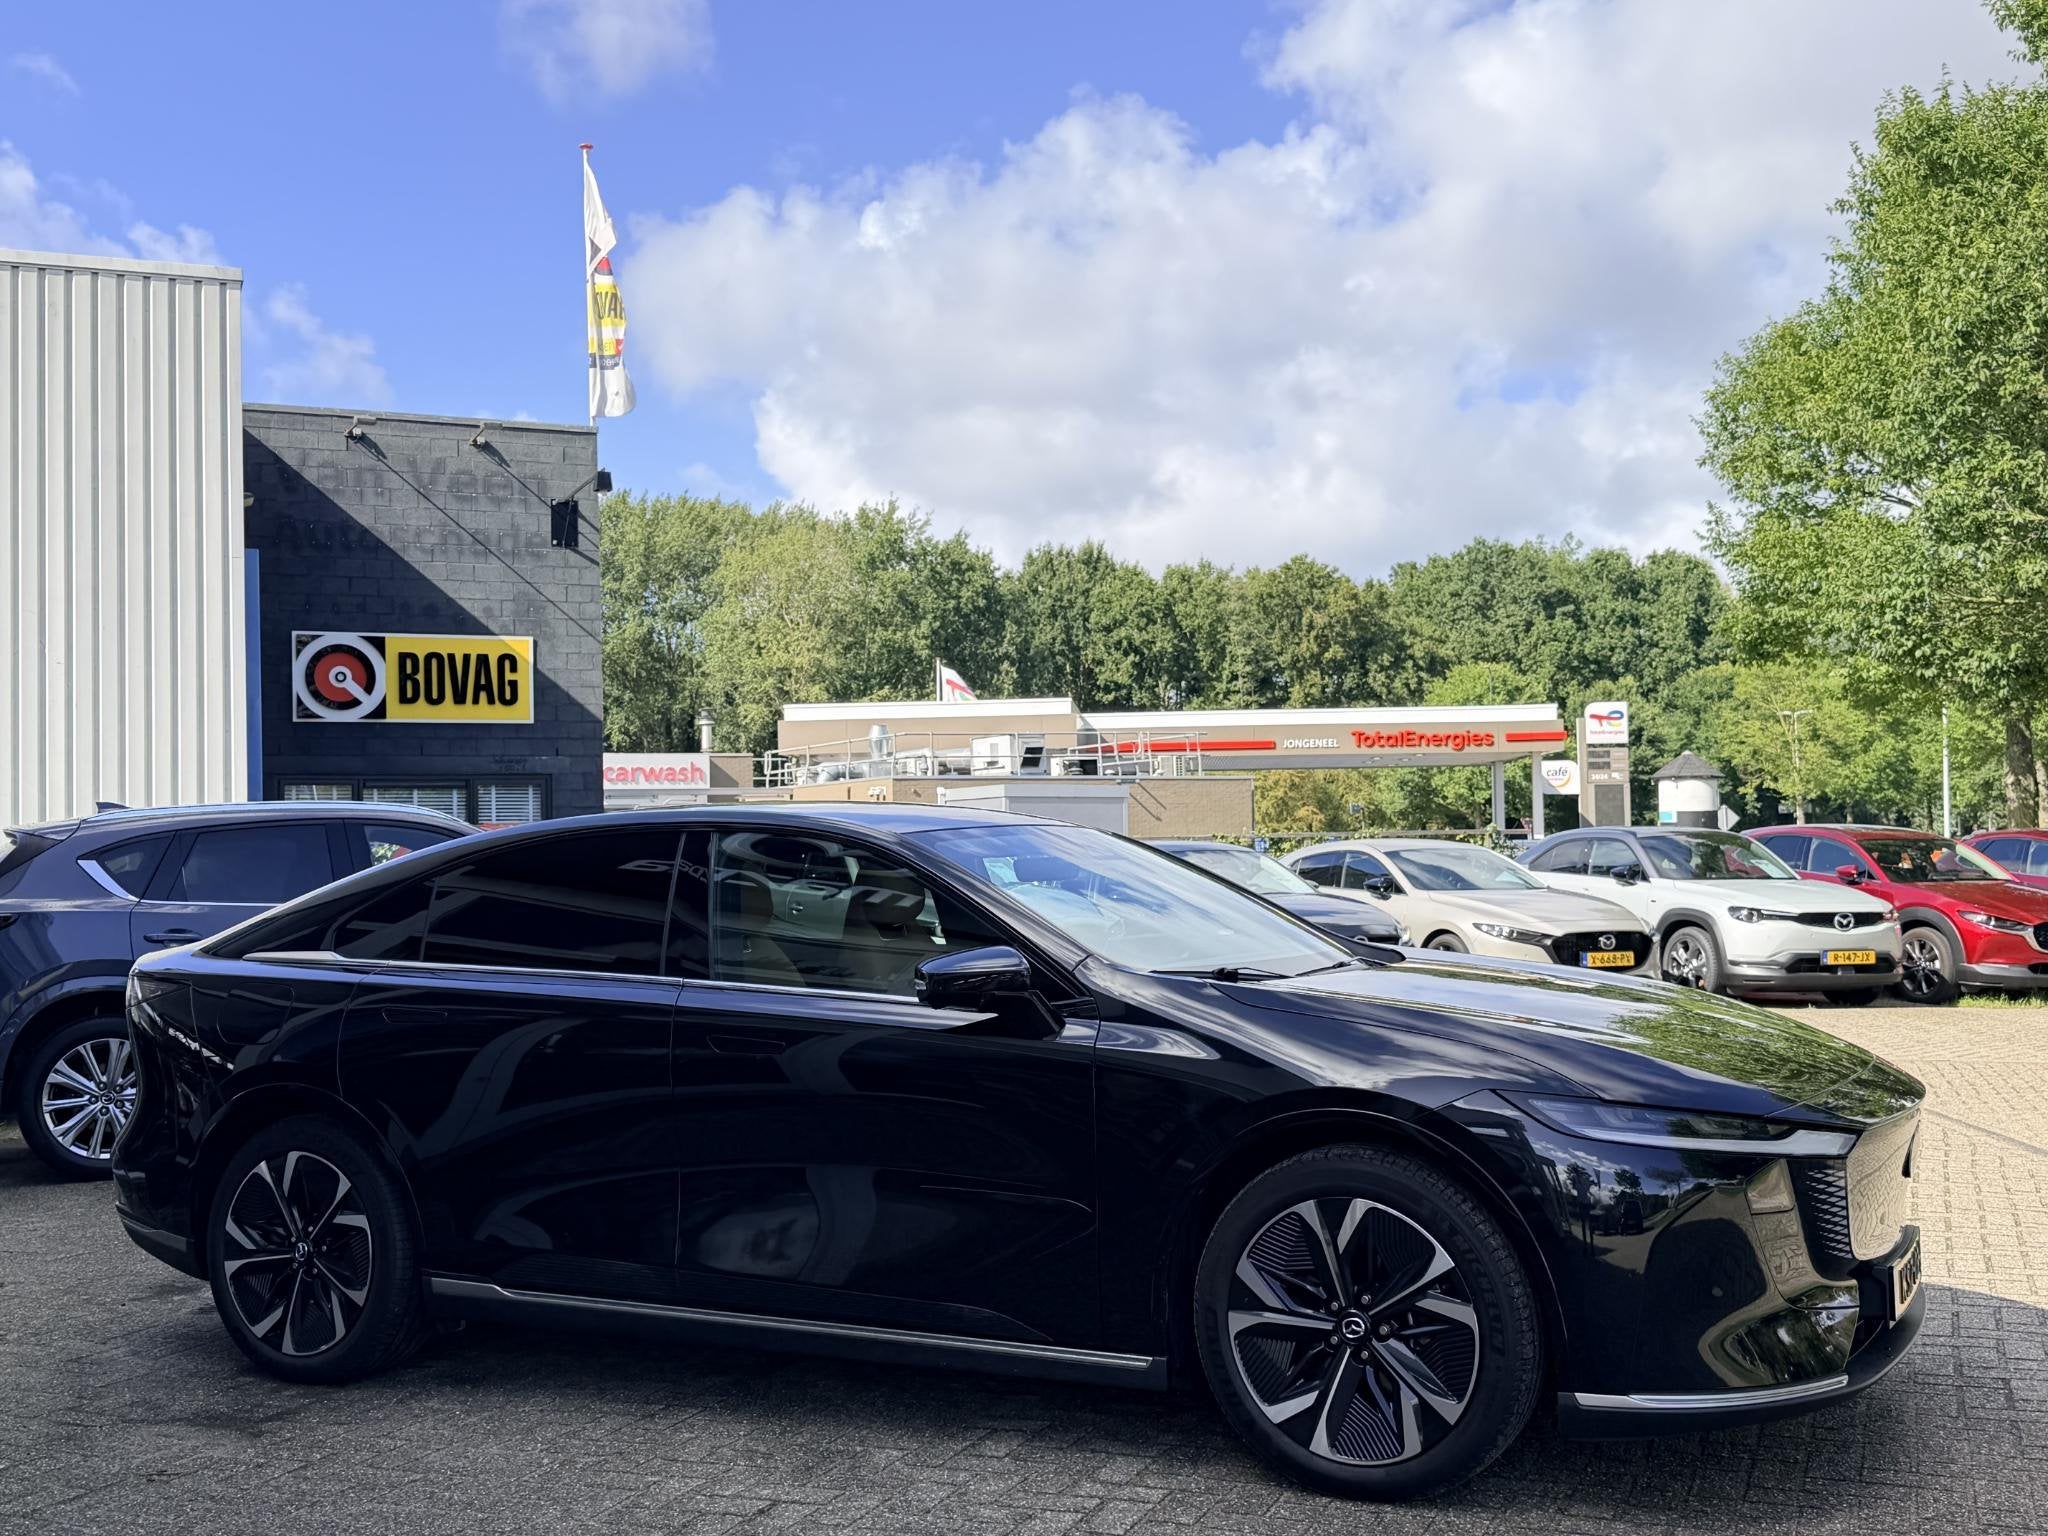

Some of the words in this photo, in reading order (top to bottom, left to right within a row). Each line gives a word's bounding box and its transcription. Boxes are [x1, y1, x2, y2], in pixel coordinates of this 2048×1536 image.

[397, 651, 519, 706] BOVAG
[1283, 738, 1340, 749] JONGENEEL
[1351, 729, 1495, 751] TotalEnergies
[603, 761, 705, 783] carwash
[1546, 766, 1568, 777] café
[1832, 951, 1871, 963] R-147-JX
